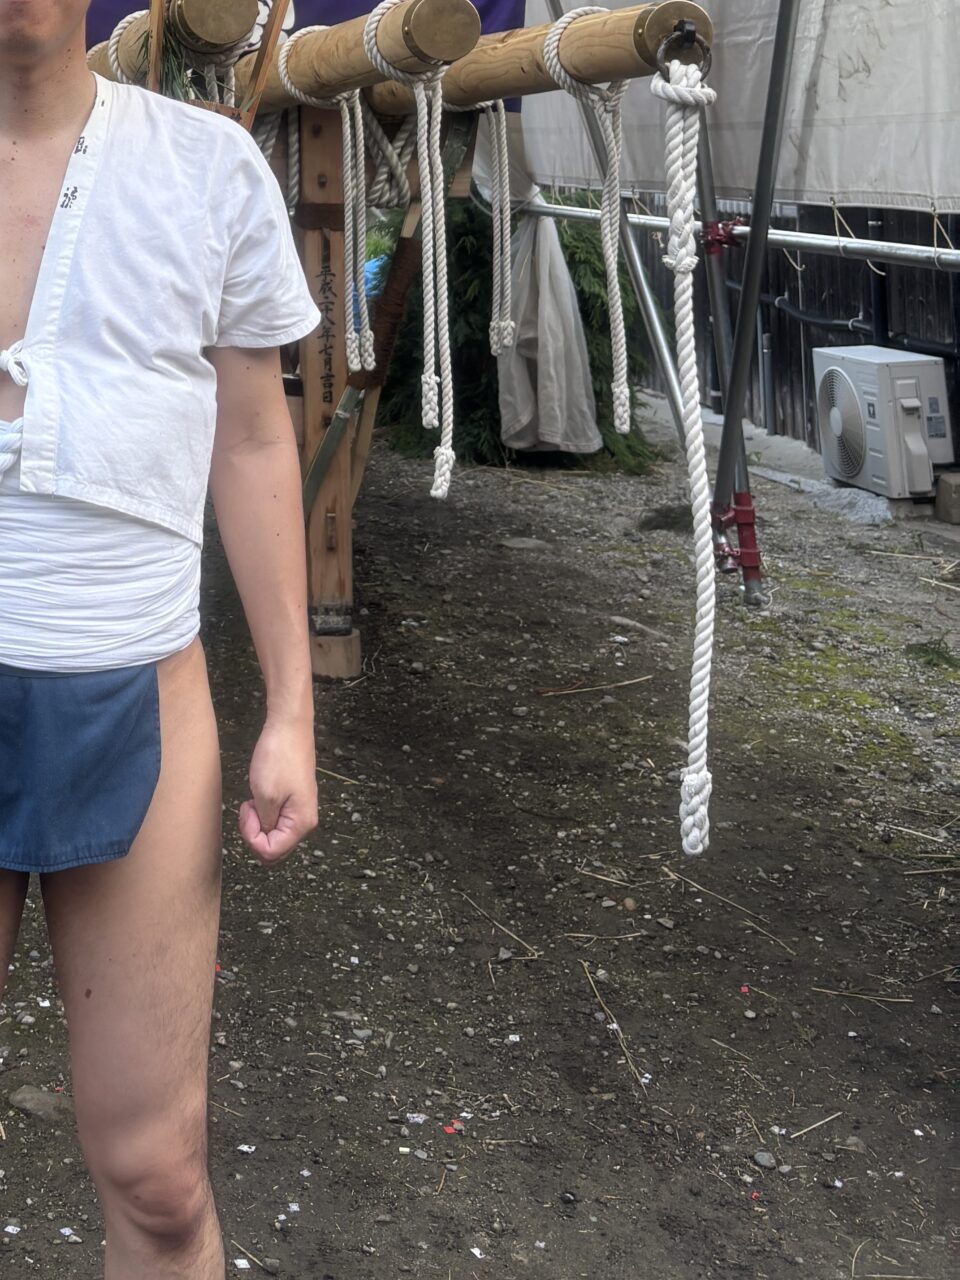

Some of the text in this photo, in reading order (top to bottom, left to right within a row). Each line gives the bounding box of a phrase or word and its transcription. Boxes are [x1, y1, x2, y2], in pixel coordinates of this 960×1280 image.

[315, 265, 338, 403] 平成二十八年七月吉日
